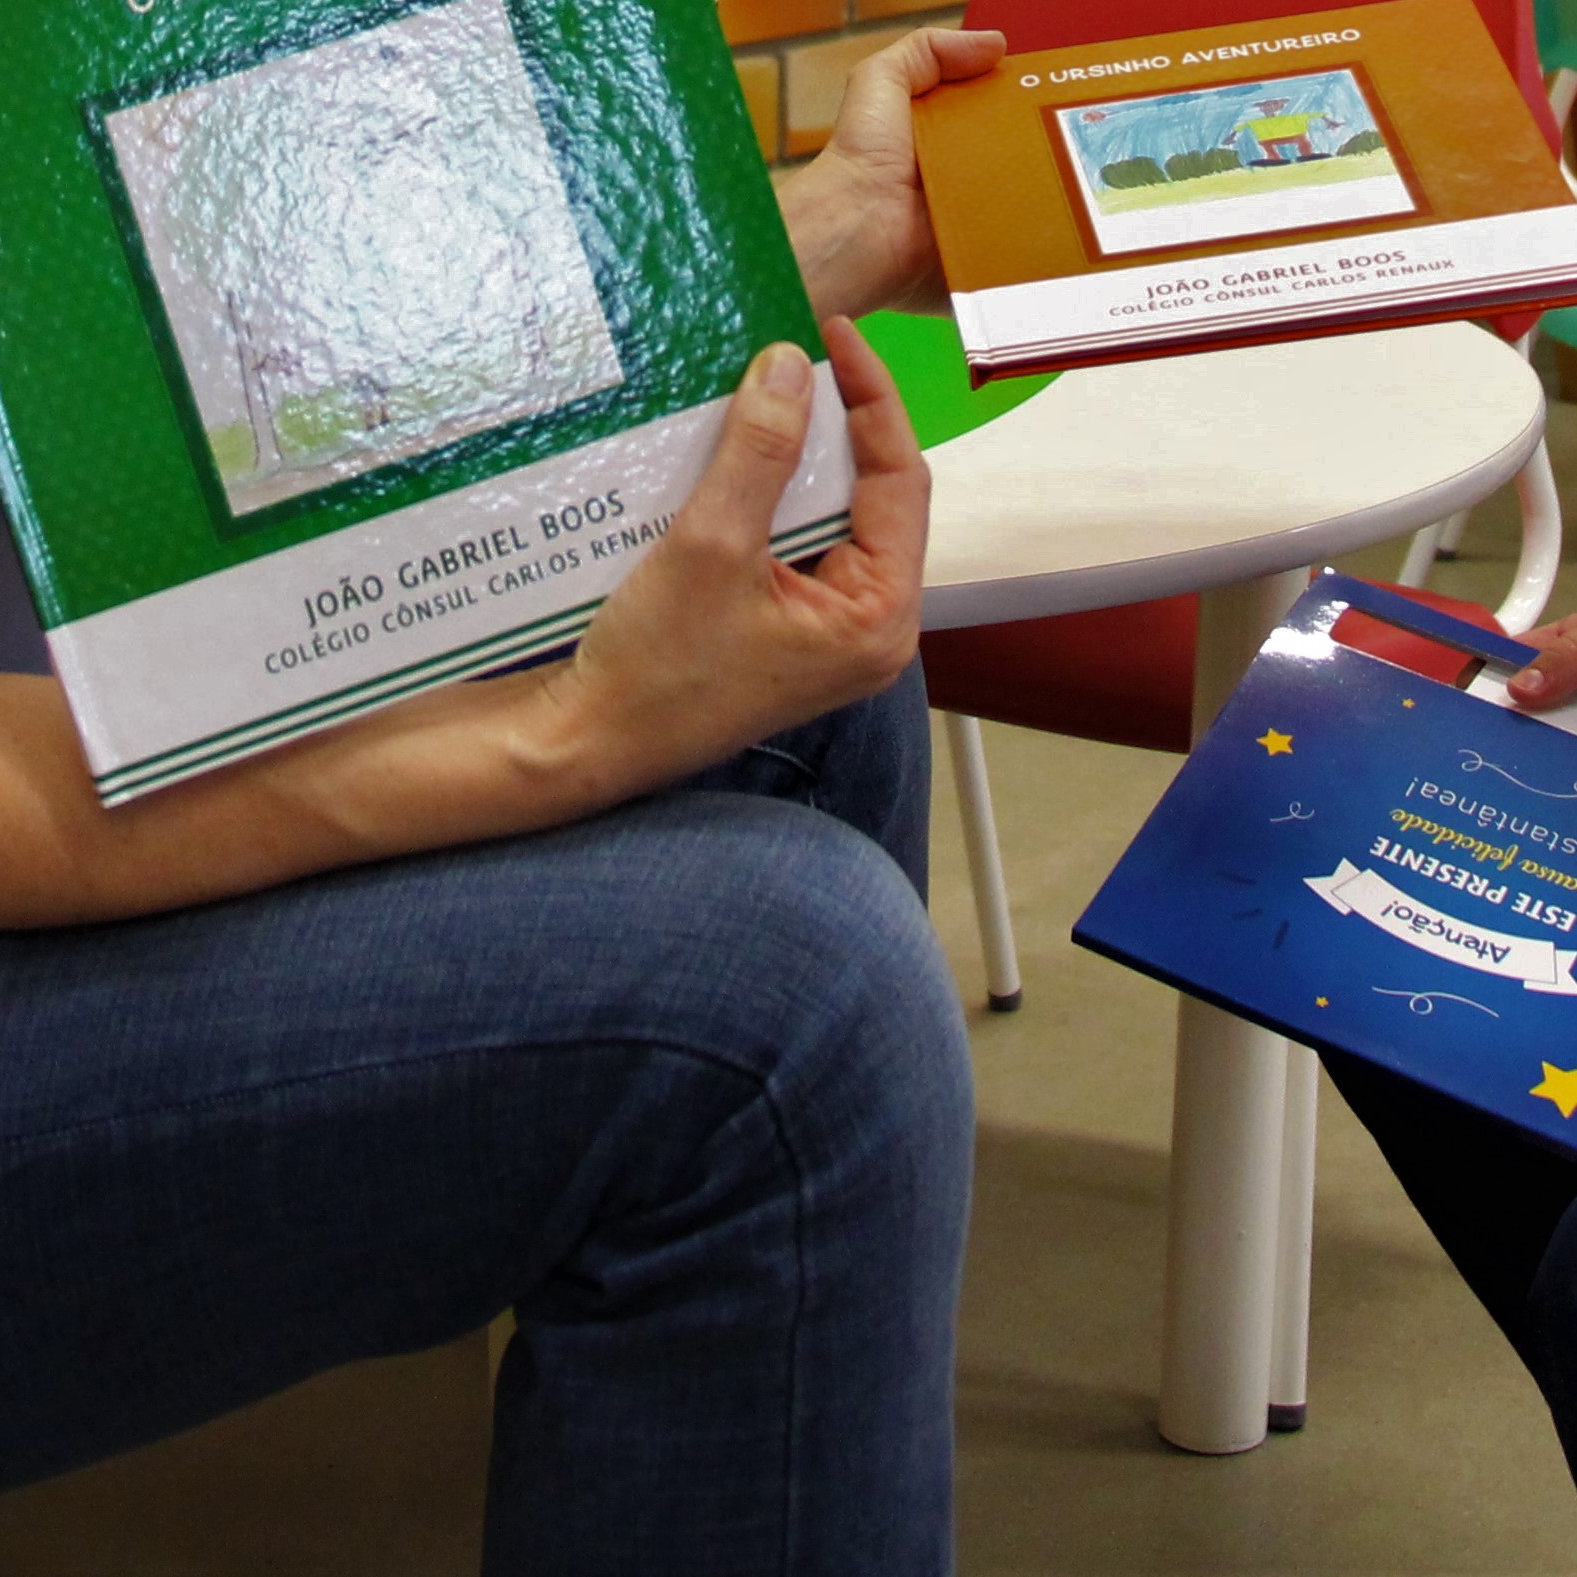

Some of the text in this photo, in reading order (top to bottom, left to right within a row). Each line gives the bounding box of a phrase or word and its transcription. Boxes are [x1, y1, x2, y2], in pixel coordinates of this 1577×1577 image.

[1020, 28, 1361, 87] O URSINHO AVENTUREIRO
[1108, 259, 1456, 318] COLÉGIO CÔNSUL CARLOS RENAUX
[1146, 250, 1407, 299] JOÃO GABRIEL BOOS
[303, 489, 624, 627] JOÃO GABRIEL BOOS
[264, 622, 371, 674] COLÉGIO
[381, 584, 479, 633] CÔNSUL
[591, 513, 675, 560] RENAU
[1389, 808, 1519, 871] felicidade
[1369, 835, 1577, 932] ESTE PRESENTE
[1380, 899, 1511, 964] Atenção!
